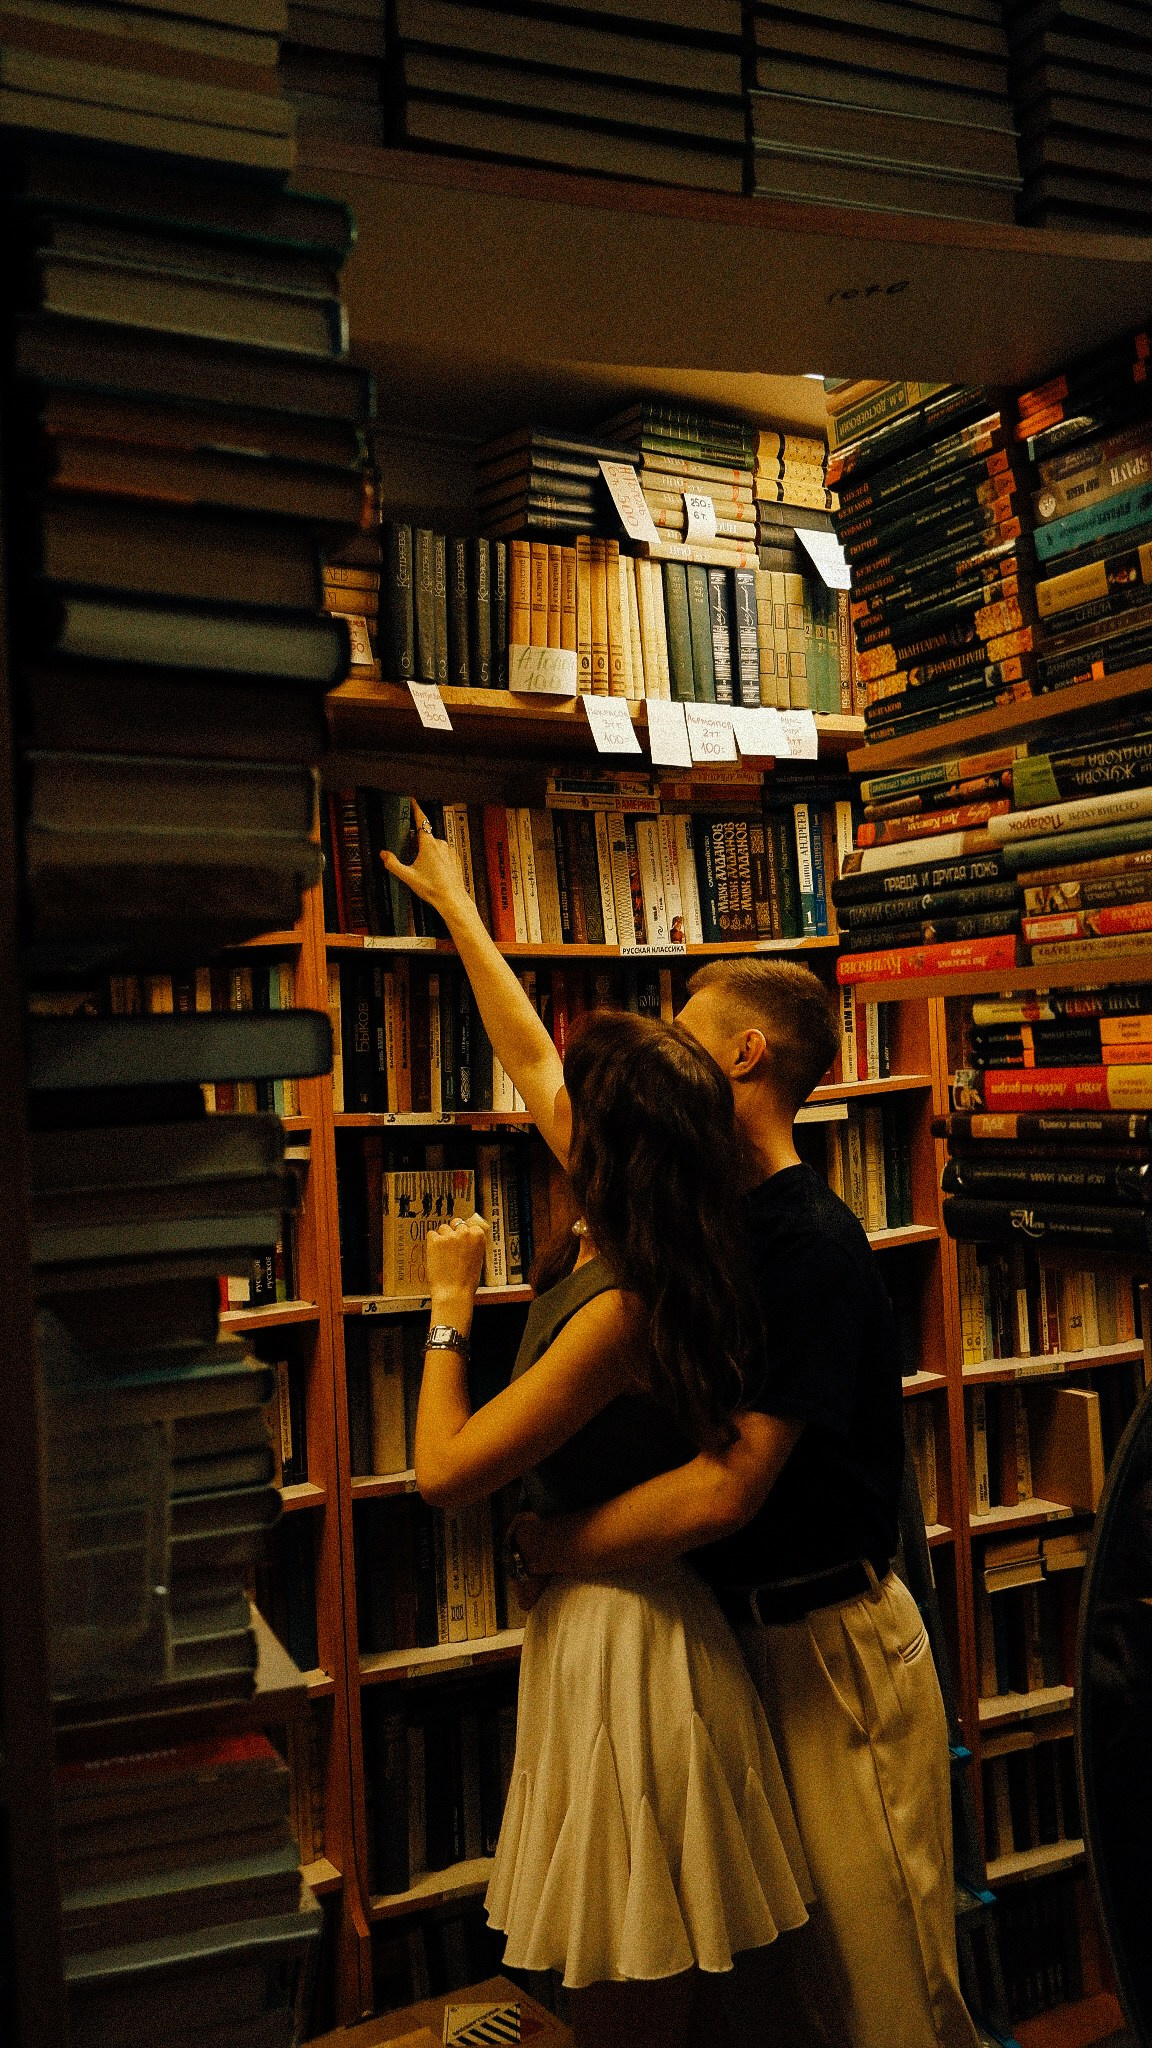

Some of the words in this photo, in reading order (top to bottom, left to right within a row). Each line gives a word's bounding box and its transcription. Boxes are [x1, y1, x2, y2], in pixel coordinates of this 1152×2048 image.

[401, 651, 410, 668] 6
[426, 657, 435, 674] 1
[438, 660, 447, 678] 3
[459, 663, 467, 680] 4
[480, 663, 489, 681] 5
[798, 811, 809, 856] АНДРЕЕВ
[1008, 813, 1062, 832] Подарок
[711, 823, 727, 881] АЛДАНОВ
[724, 821, 738, 879] АЛДАНОВ
[735, 821, 751, 879] АЛДАНОВ
[883, 871, 918, 893] ПРАВДА
[921, 872, 930, 888] И
[932, 864, 966, 887] ДРУГАЯ
[968, 860, 999, 880] ЛОЖЬ
[806, 911, 813, 924] 1
[621, 946, 650, 956] РУССКАЯ
[650, 944, 685, 954] КЛАССИКА
[839, 953, 902, 976] Куликова
[843, 985, 852, 1008] УЧИ
[355, 1002, 369, 1053] БЫКОВ
[844, 1011, 853, 1033] ДОМ
[265, 1256, 273, 1290] РУССКОЕ
